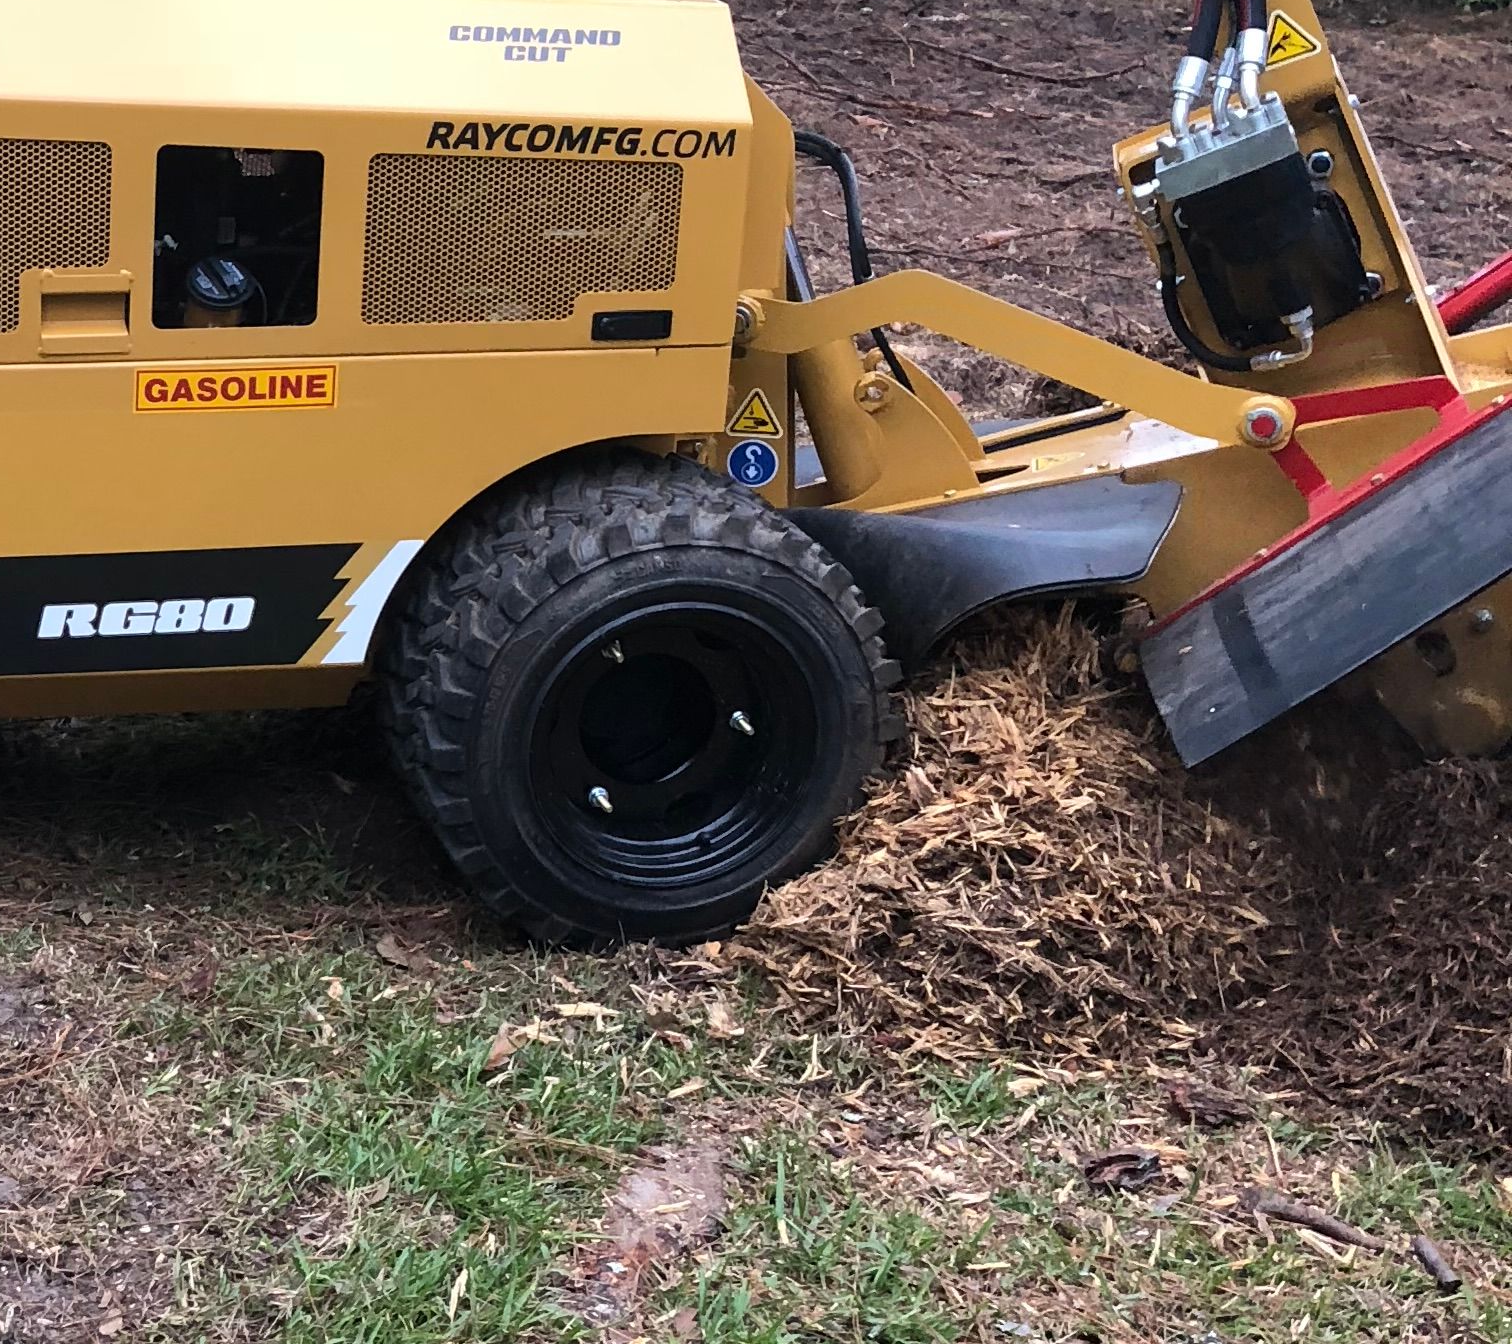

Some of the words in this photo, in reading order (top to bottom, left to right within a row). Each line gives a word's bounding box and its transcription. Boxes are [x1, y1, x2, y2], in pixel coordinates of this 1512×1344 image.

[449, 25, 622, 46] COMMAND
[504, 45, 572, 63] CUT
[425, 120, 737, 159] RAYCOMFG.COM
[143, 373, 328, 403] GASOLINE
[37, 596, 256, 640] RG80
